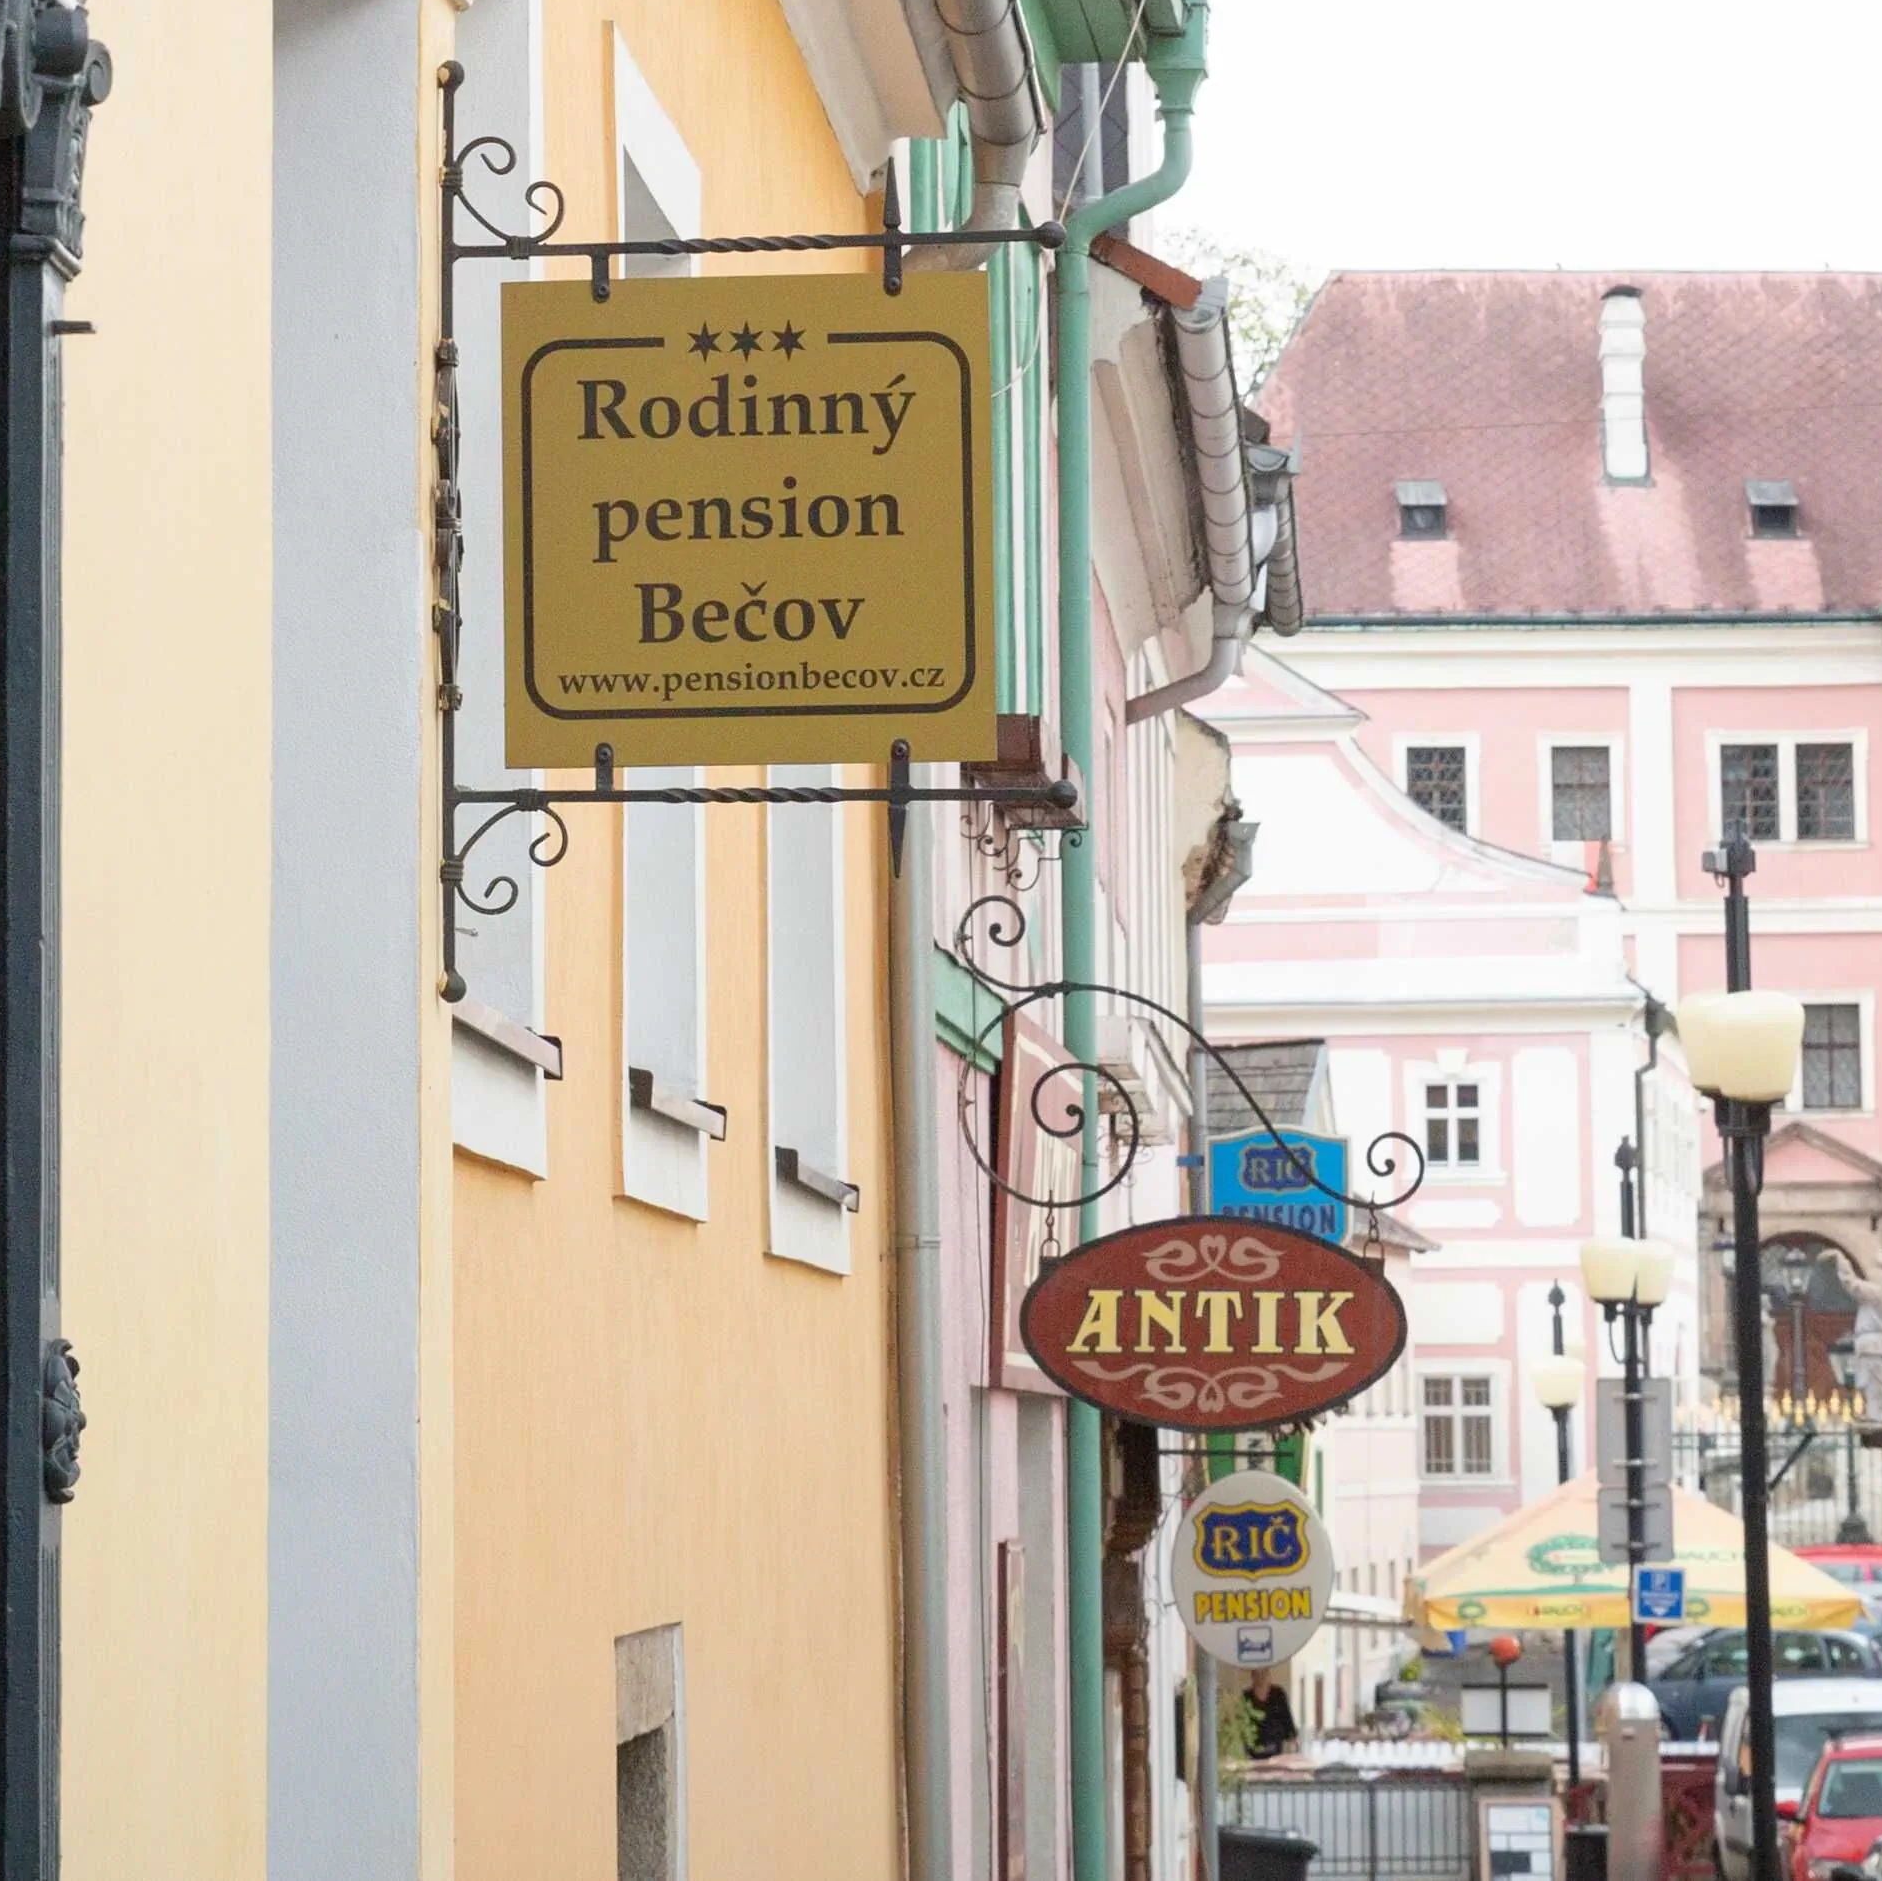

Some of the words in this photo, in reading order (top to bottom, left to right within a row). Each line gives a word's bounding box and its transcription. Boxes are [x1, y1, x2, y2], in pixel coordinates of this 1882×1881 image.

[575, 372, 917, 456] Rodinný
[591, 475, 906, 565] pension
[633, 580, 867, 645] Bečov
[557, 661, 946, 702] www.pensionbecov.cz
[1065, 1289, 1356, 1355] ANTIK
[1212, 1515, 1293, 1562] RIČ
[1195, 1586, 1313, 1626] PENSION
